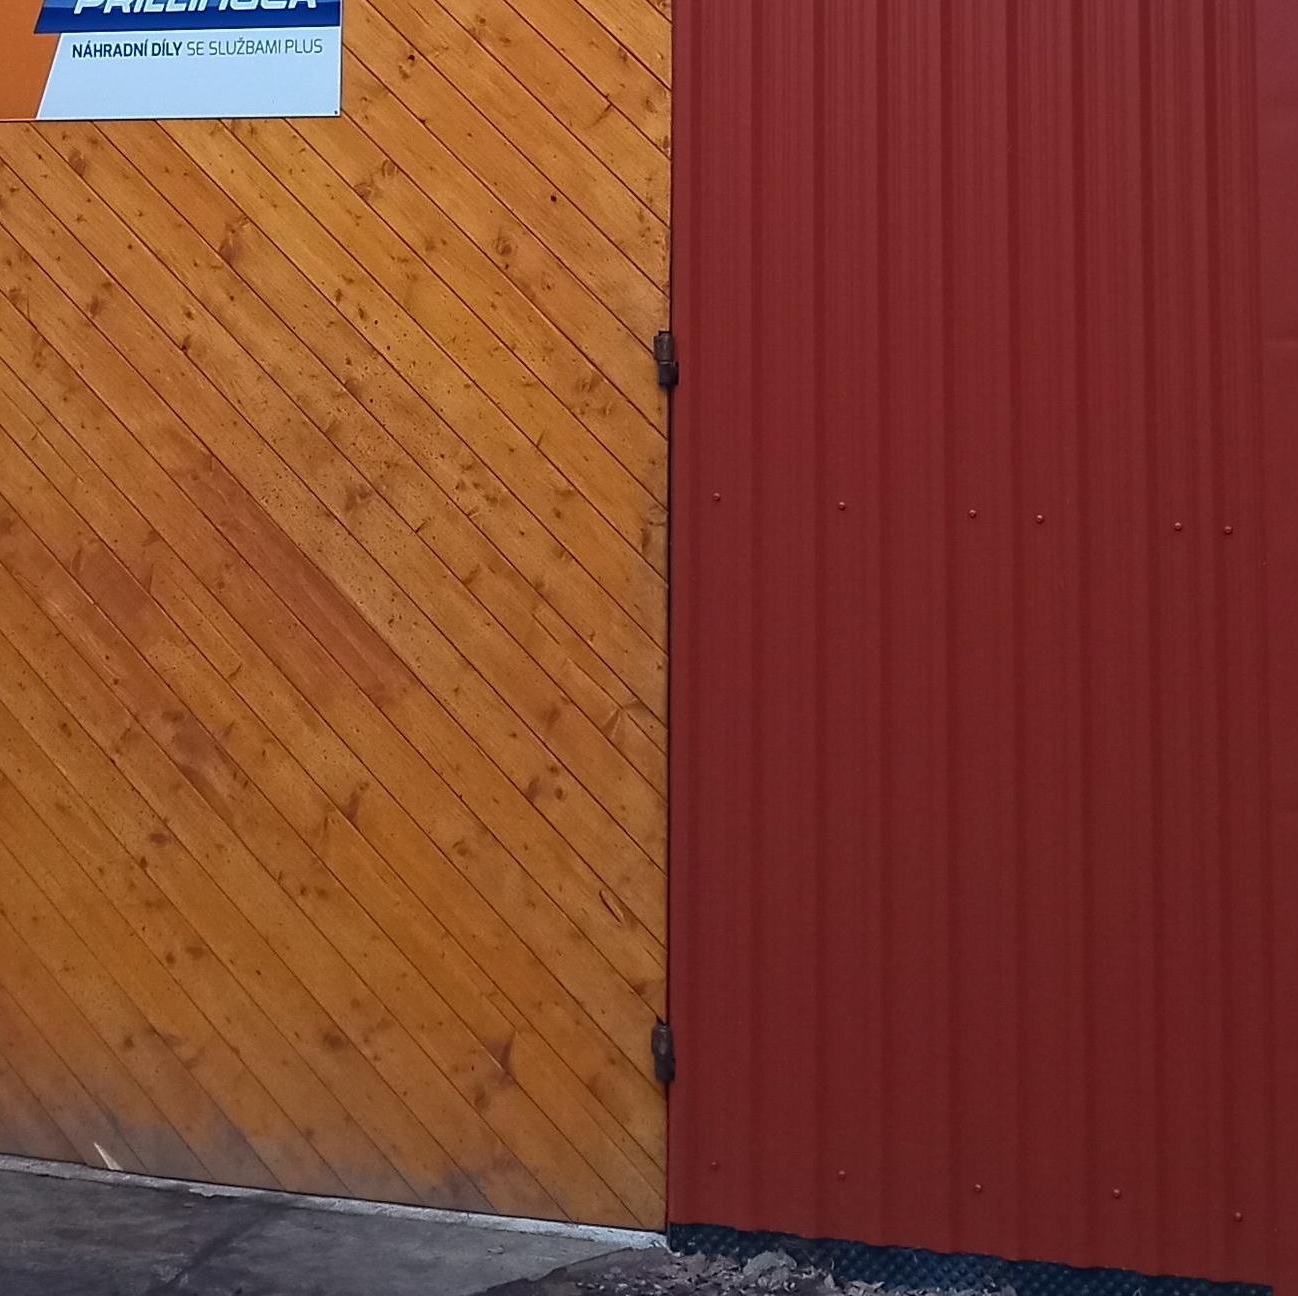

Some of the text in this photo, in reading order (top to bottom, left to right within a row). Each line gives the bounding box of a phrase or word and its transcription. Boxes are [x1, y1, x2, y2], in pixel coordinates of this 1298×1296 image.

[72, 37, 323, 58] NÁHRADNÍ DÍLY SE SLUŽBAMI PLUS
